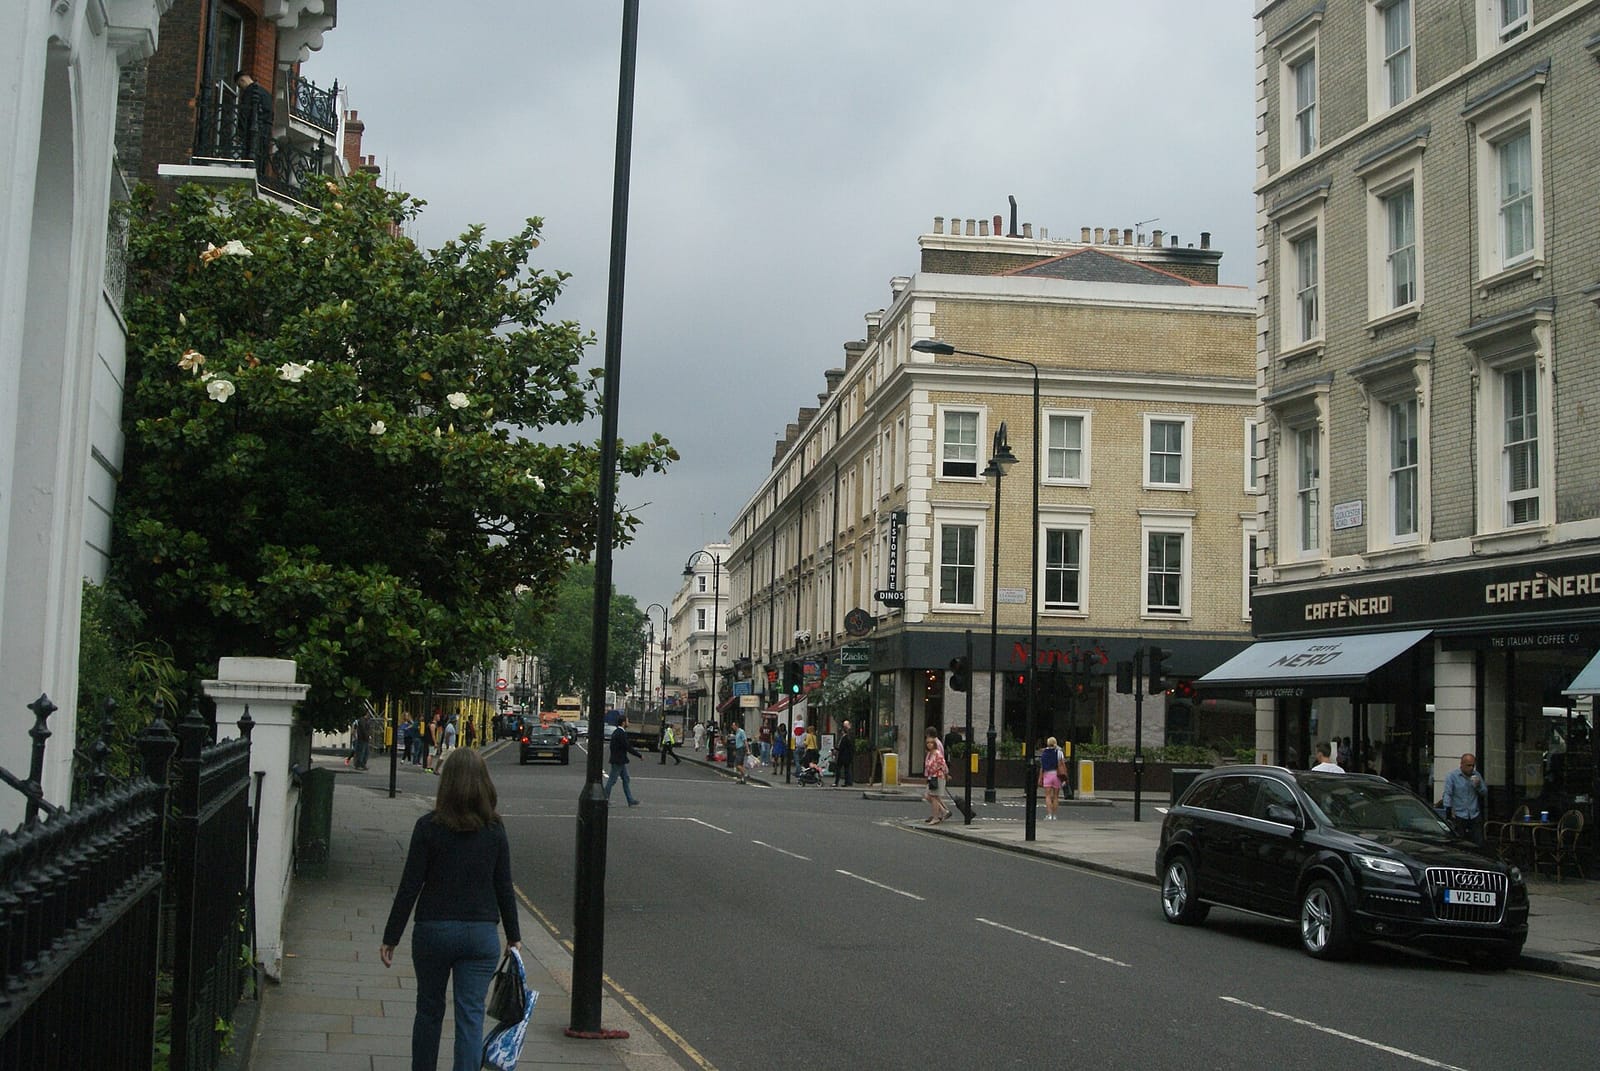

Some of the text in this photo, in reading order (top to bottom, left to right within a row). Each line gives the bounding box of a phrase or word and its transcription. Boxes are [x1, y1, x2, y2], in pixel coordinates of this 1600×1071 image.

[889, 512, 897, 590] RISTORANTE
[1349, 596, 1392, 616] NERO
[1491, 638, 1504, 647] THE
[1507, 636, 1533, 646] ITALIAN
[1537, 634, 1565, 645] COFFEE
[1269, 652, 1343, 668] NERO
[1245, 689, 1254, 697] THE
[1255, 688, 1273, 697] ITALIAN
[1274, 688, 1295, 697] COFFEE
[1456, 891, 1491, 904] V12 ELO
